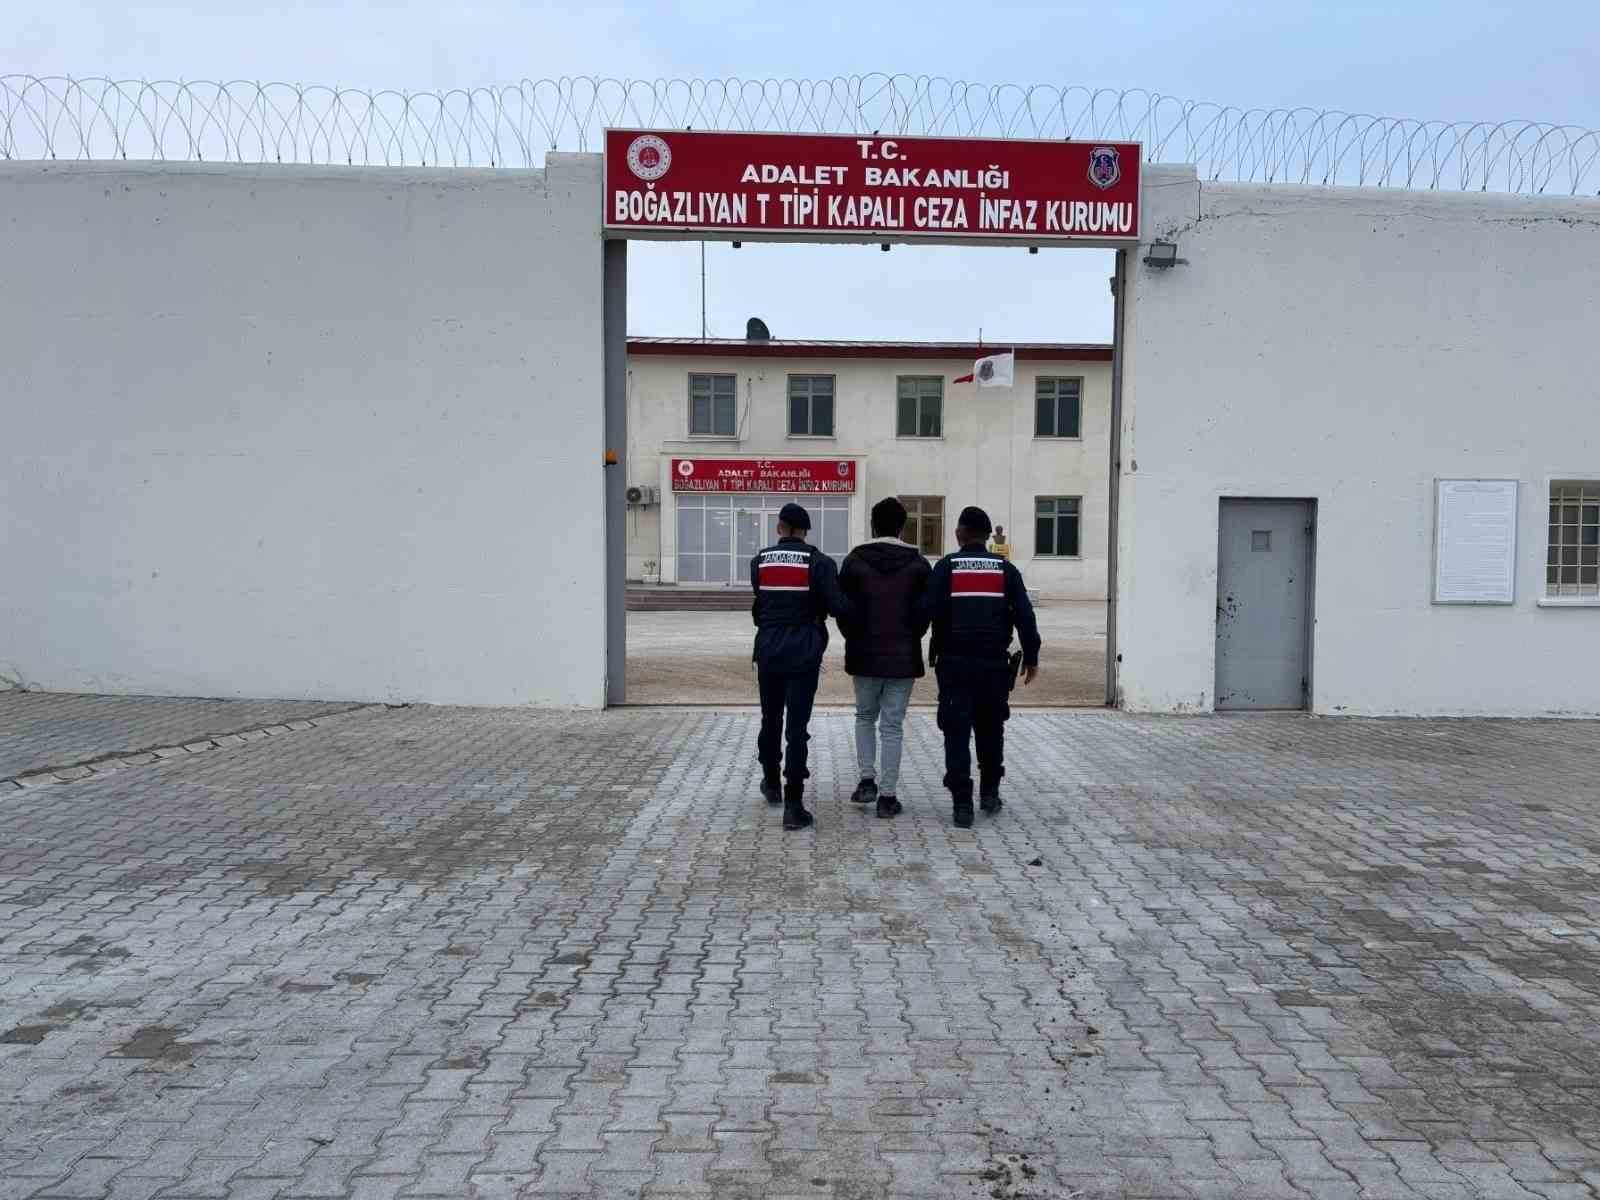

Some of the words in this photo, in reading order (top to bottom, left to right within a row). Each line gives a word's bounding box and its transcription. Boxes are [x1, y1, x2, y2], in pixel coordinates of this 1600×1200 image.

[858, 139, 907, 161] T.C.
[740, 164, 848, 185] ADALET
[865, 163, 1009, 190] BAKANLIĞI
[615, 183, 747, 224] BOĞAZLIYAN
[756, 193, 770, 225] T
[779, 187, 819, 227] TİPİ
[826, 194, 904, 228] KAPALI
[913, 195, 968, 230] CEZA
[979, 191, 1036, 231] İNFAZ
[1045, 200, 1133, 234] KURUMU
[718, 469, 755, 478] ADALET
[763, 552, 803, 563] JANDARMA
[956, 559, 999, 569] JANDARMA
